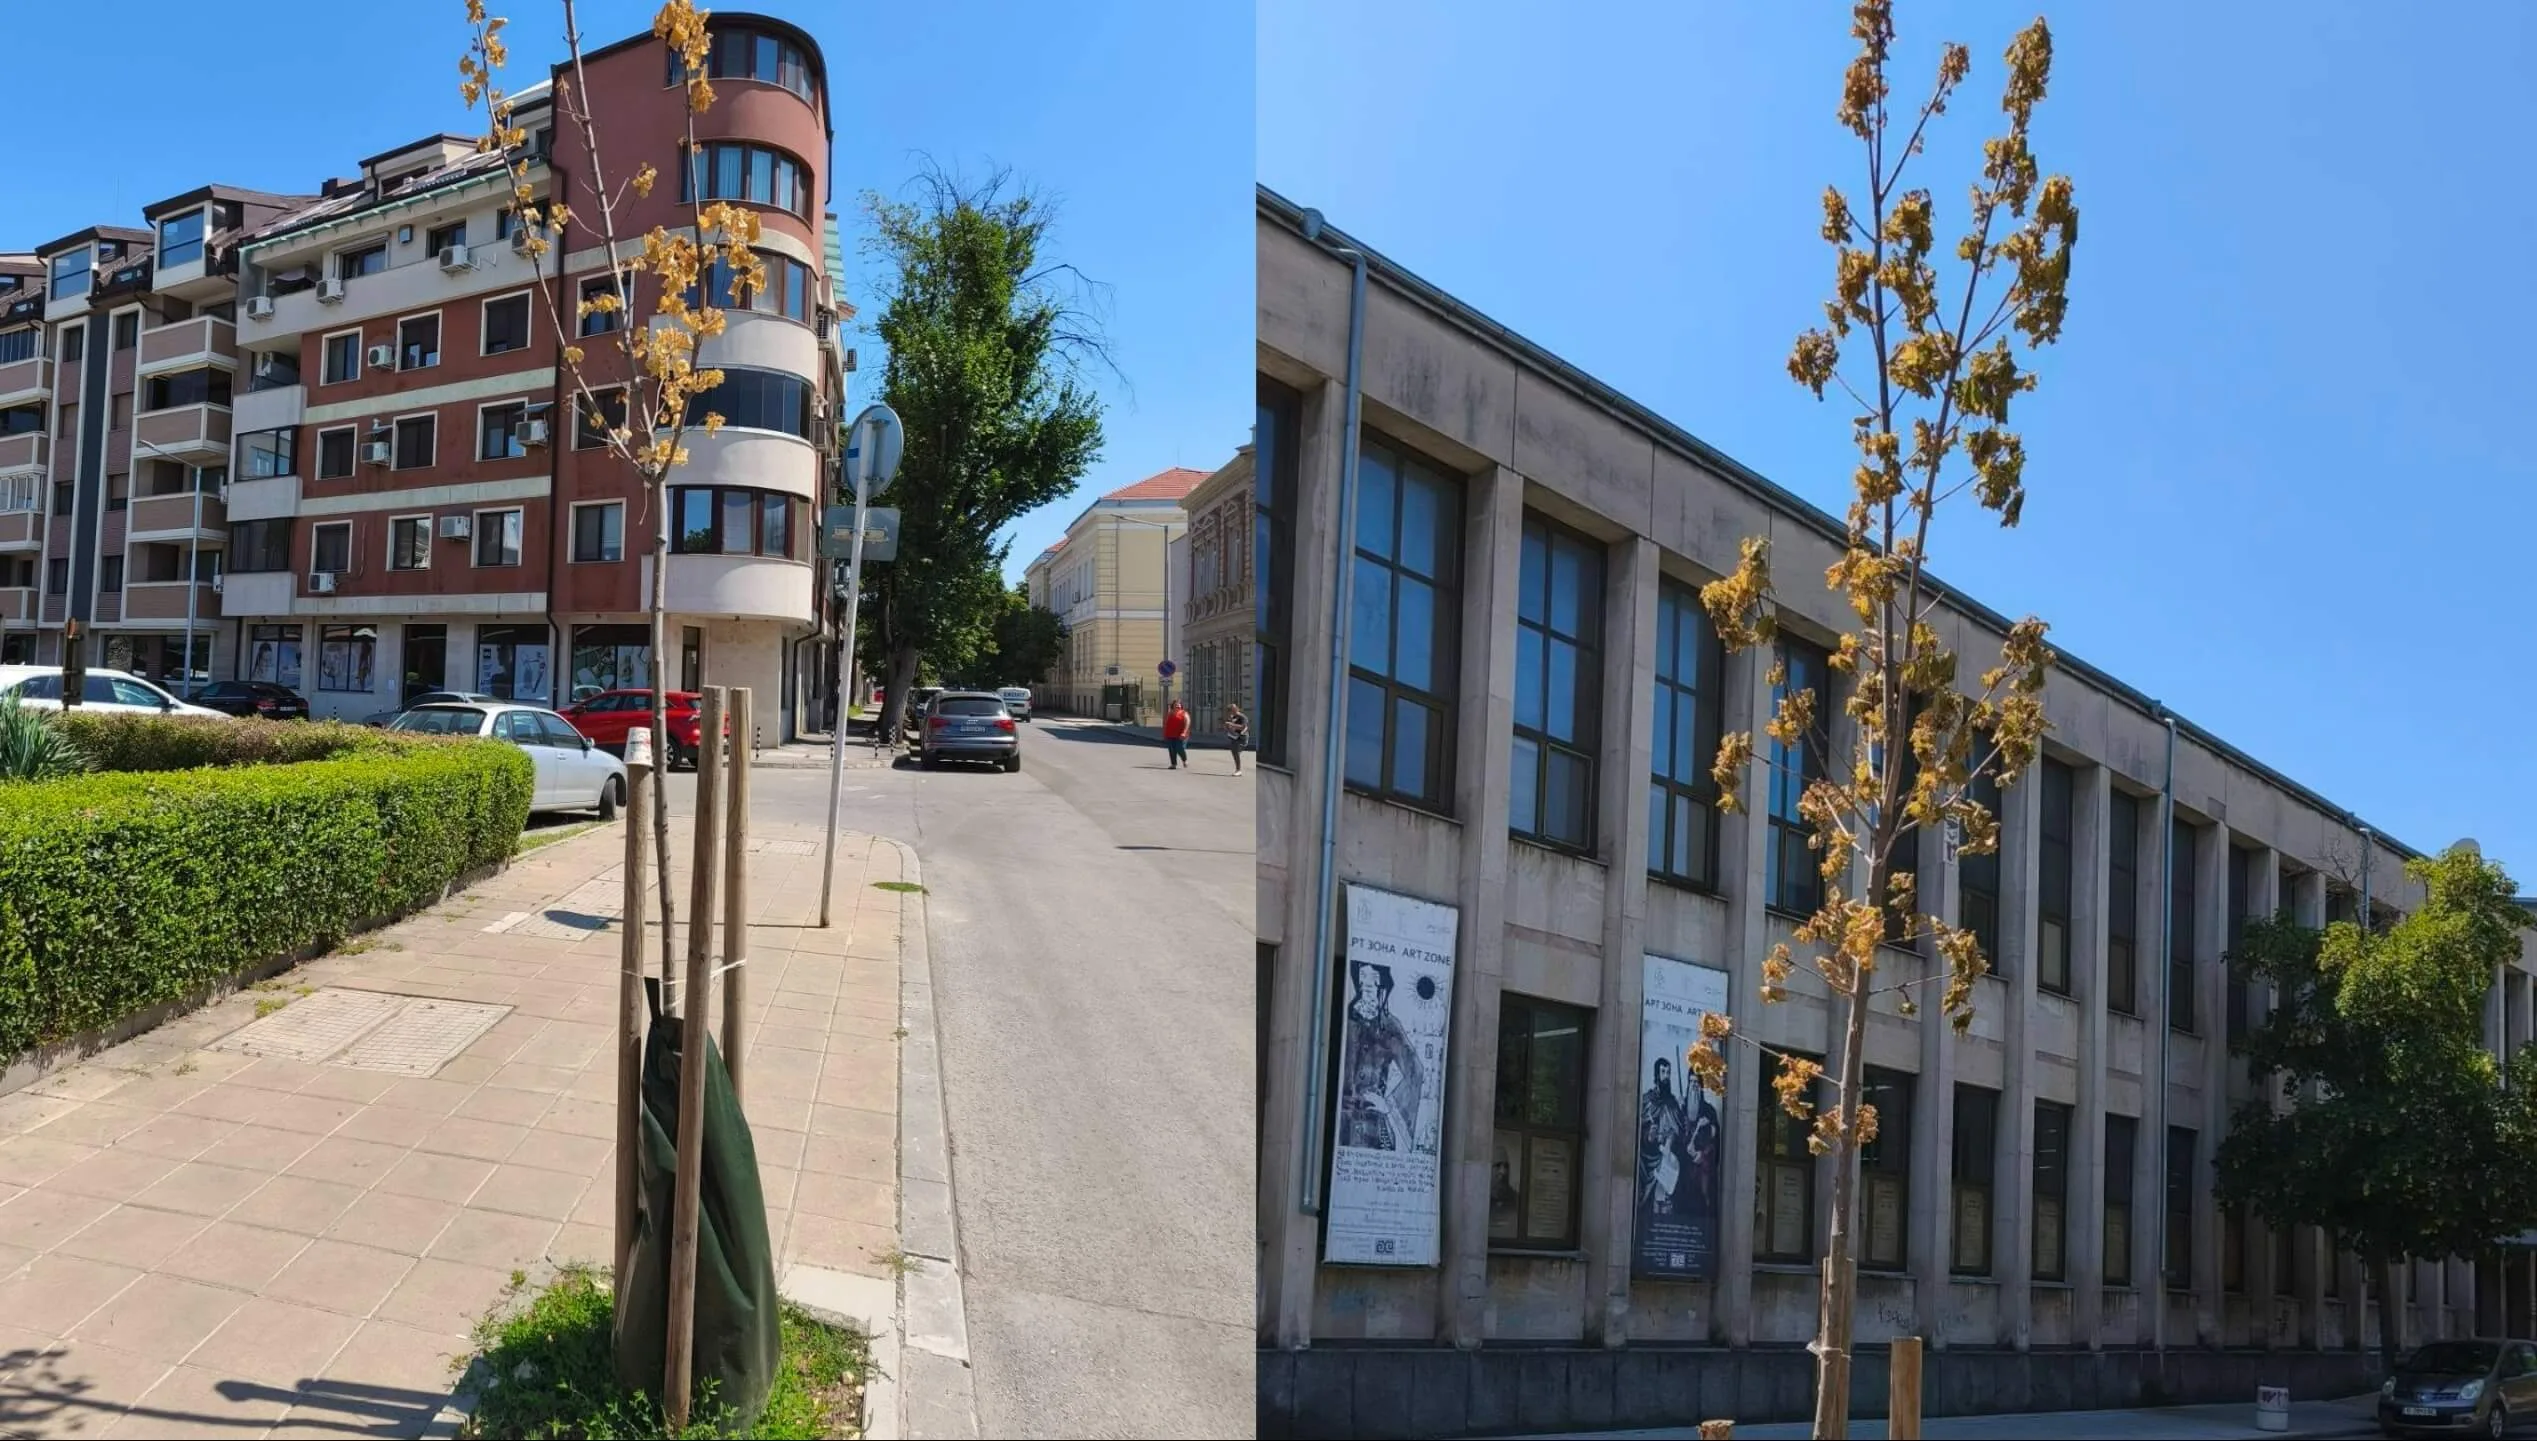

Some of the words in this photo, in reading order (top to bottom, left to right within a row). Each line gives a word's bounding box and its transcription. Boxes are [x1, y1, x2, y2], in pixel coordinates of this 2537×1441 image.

[1350, 937, 1364, 949] РТ
[1368, 939, 1396, 954] ЗОНА
[1402, 947, 1422, 960] ART
[1424, 951, 1451, 966] ZONE
